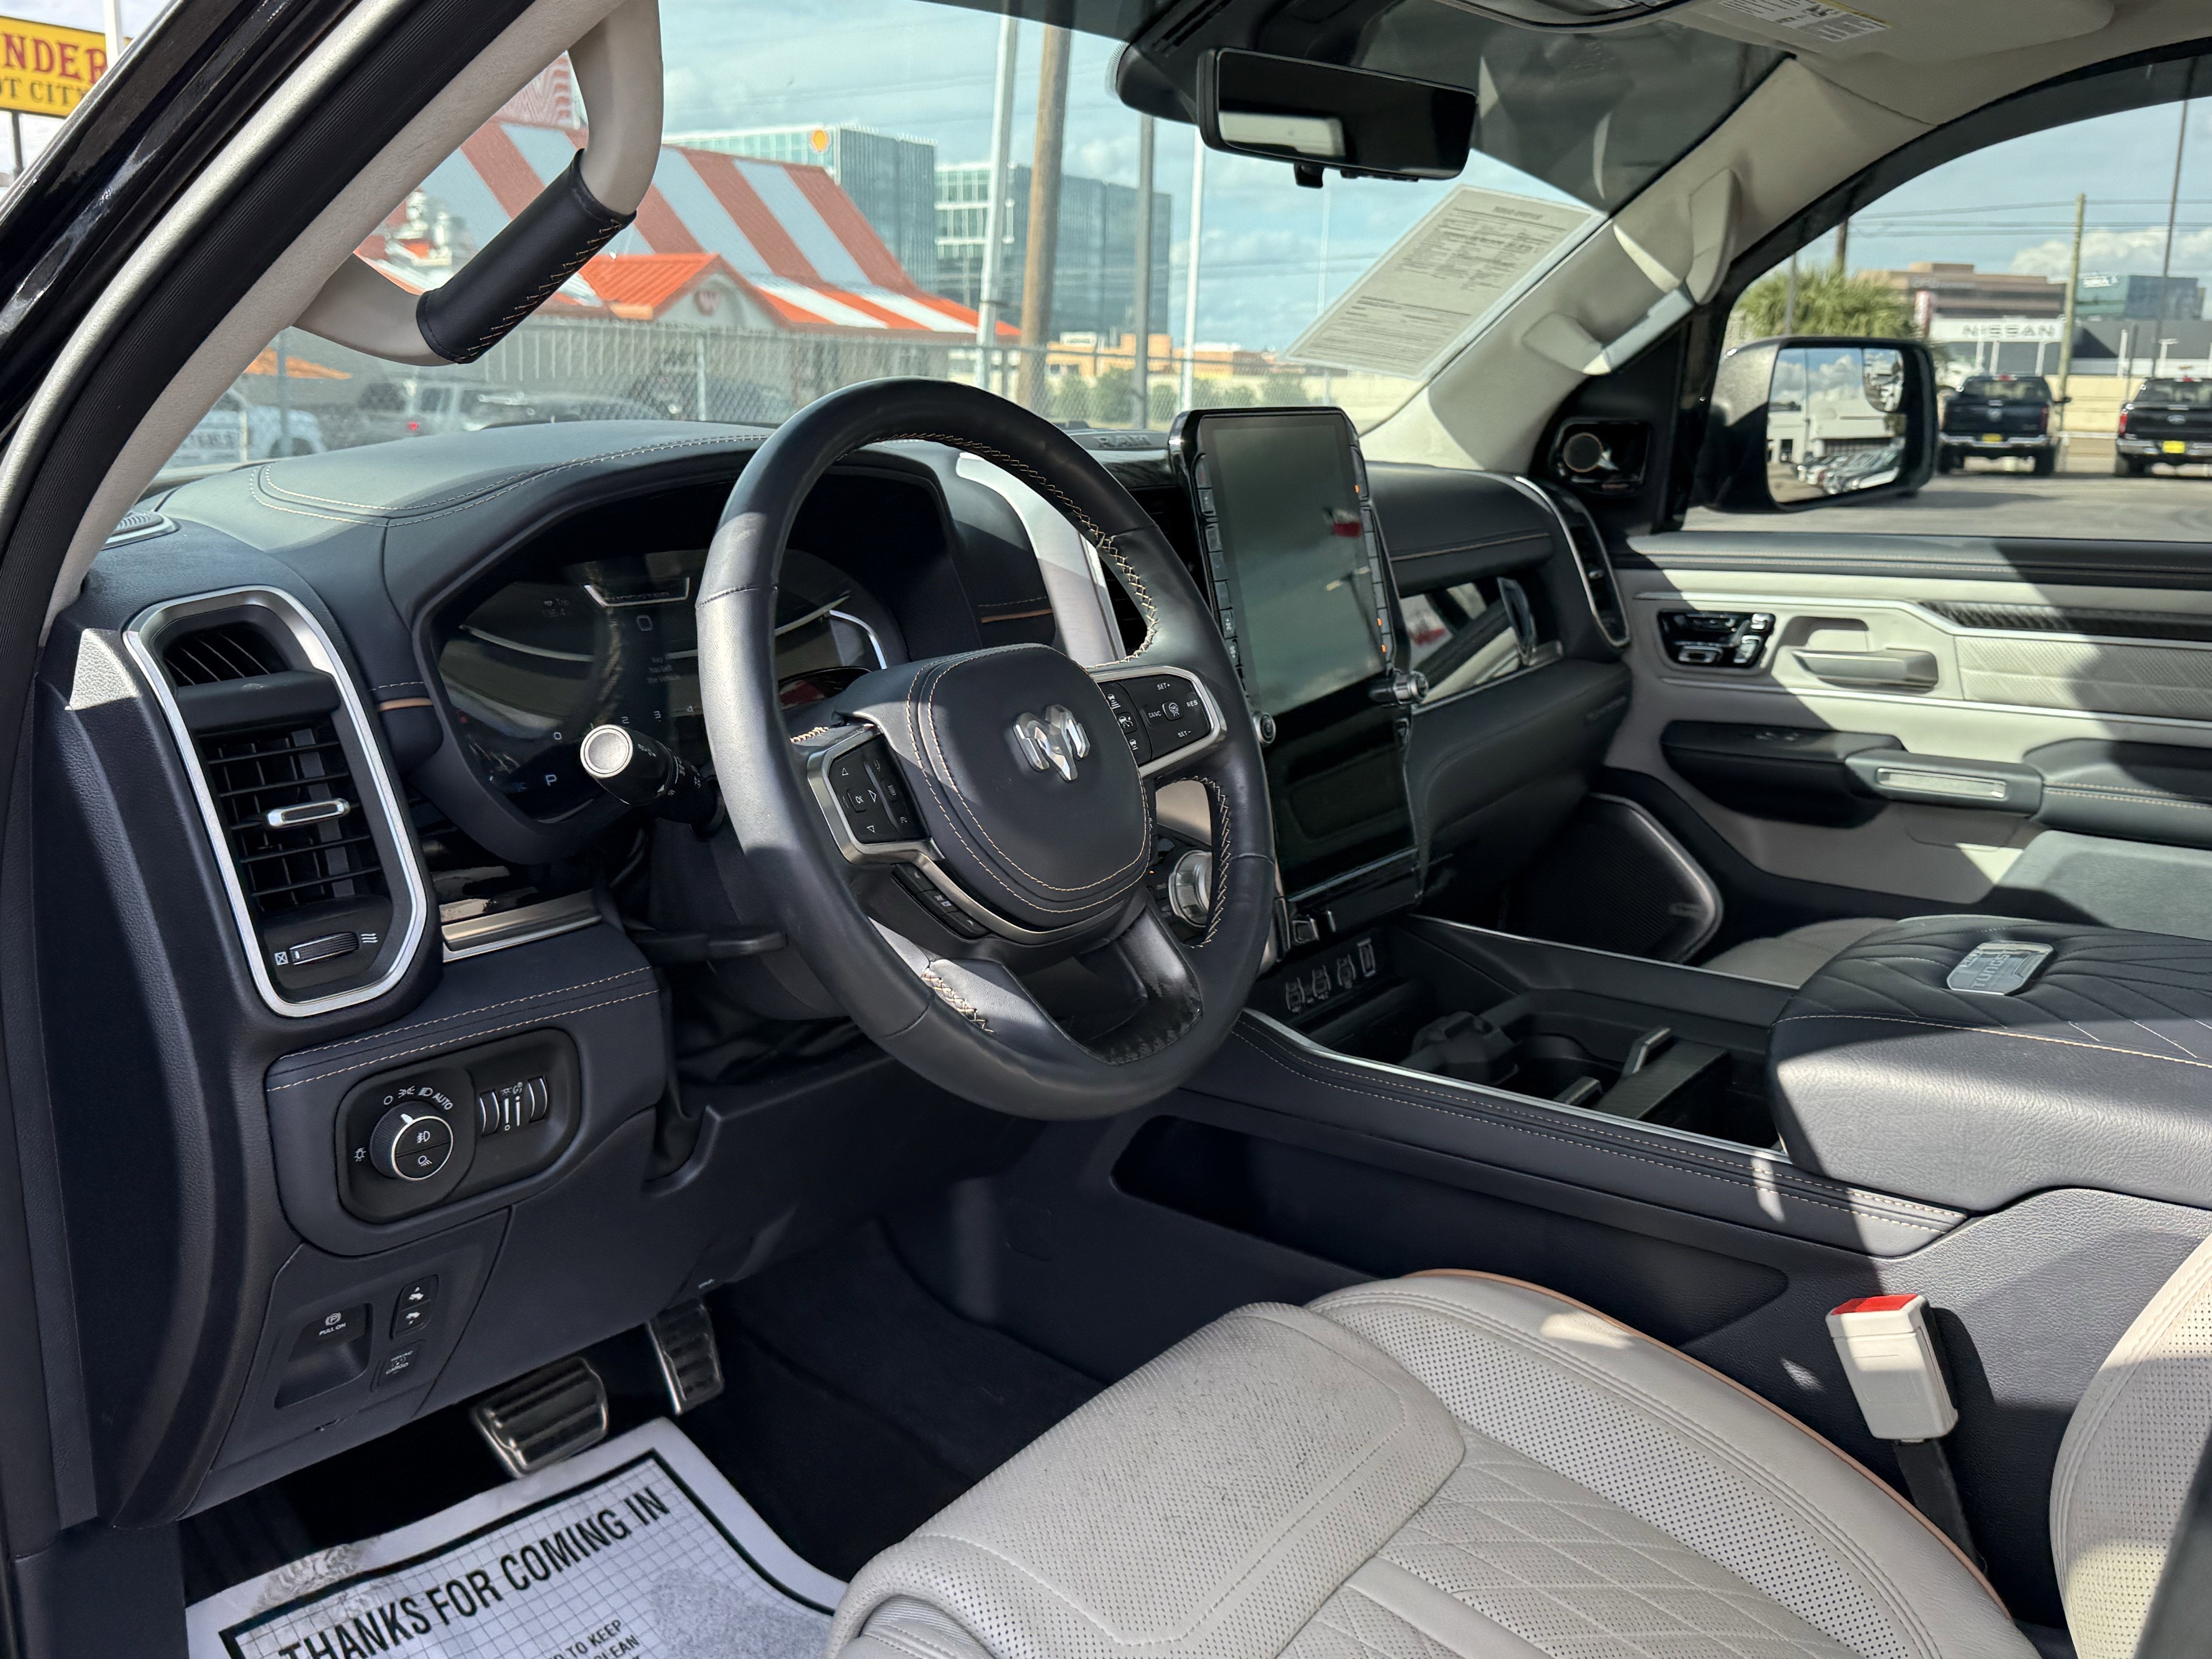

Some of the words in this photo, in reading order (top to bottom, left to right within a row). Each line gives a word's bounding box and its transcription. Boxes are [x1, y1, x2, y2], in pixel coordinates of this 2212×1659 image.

[0, 77, 21, 99] T
[29, 80, 89, 106] CIT
[1962, 325, 2057, 338] NISSAN
[1187, 699, 1198, 708] RES
[621, 716, 630, 724] 2
[553, 732, 562, 740] 0
[545, 774, 557, 786] P
[432, 1092, 453, 1110] AUTO
[319, 1327, 335, 1336] PULL
[278, 1597, 431, 1659] THANKS
[426, 1569, 503, 1626] FOR
[500, 1509, 632, 1590] COMING
[624, 1487, 670, 1526] IN
[565, 1642, 588, 1659] TO
[587, 1620, 621, 1646] KEEP
